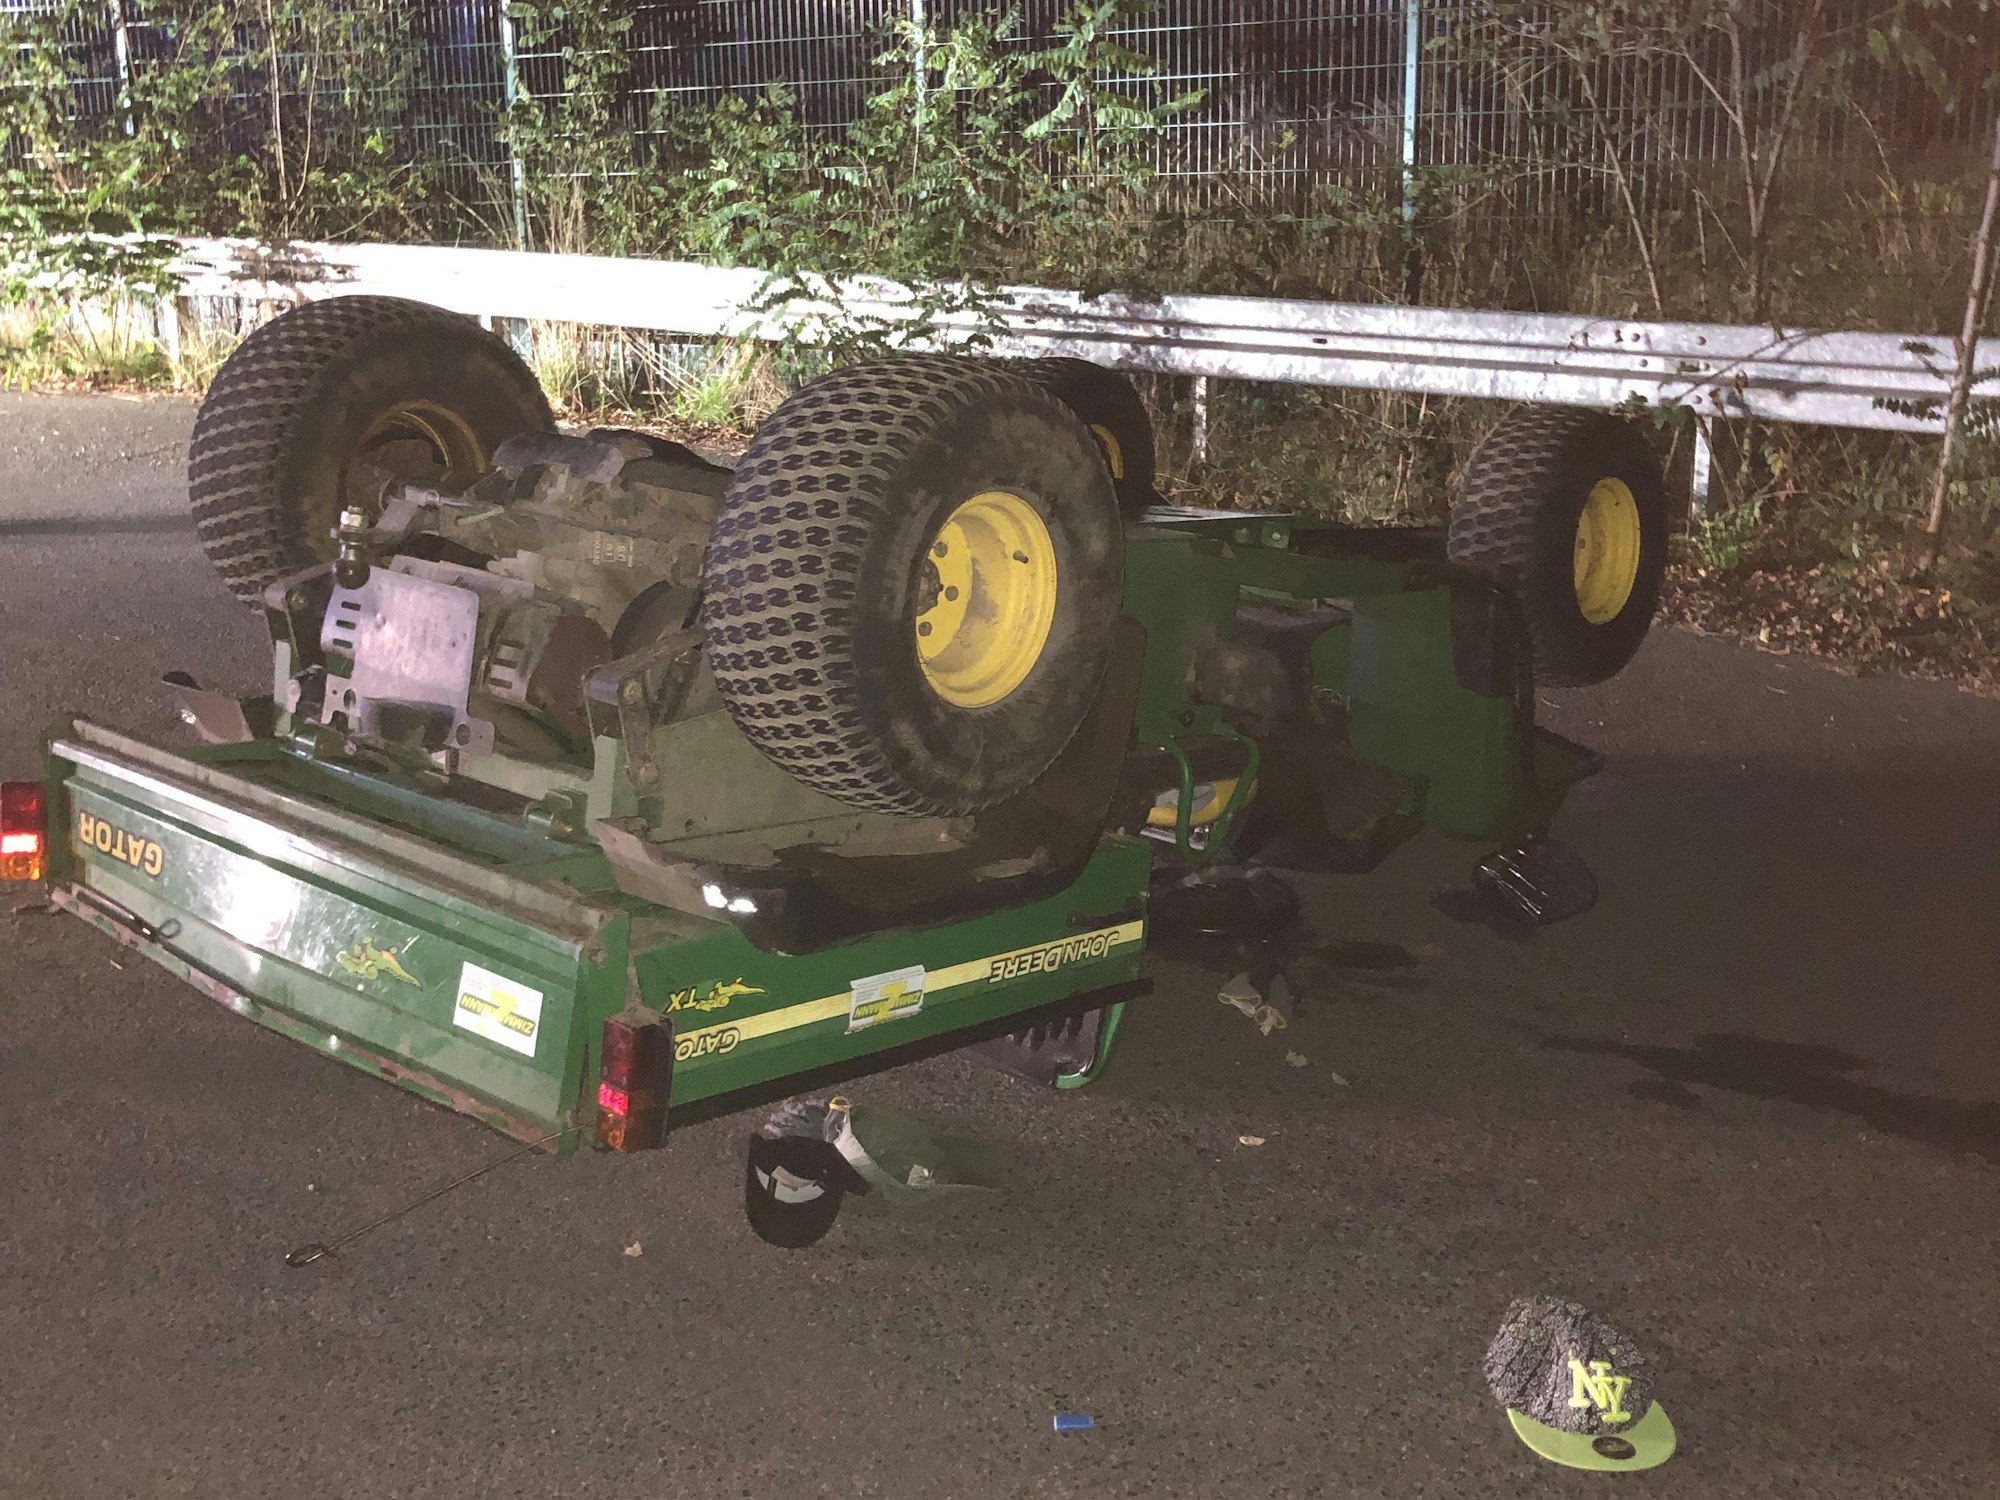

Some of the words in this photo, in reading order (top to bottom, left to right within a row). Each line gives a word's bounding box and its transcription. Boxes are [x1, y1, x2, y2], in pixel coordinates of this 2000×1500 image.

[79, 810, 164, 877] GATOR
[988, 944, 1064, 984] DEERE
[1062, 930, 1120, 964] JOHN
[459, 993, 536, 1036] ZIMMMANN
[664, 986, 698, 1014] TX
[854, 990, 922, 1020] ZIMMMANN
[674, 1026, 741, 1061] GATO
[1567, 1359, 1632, 1423] NY
